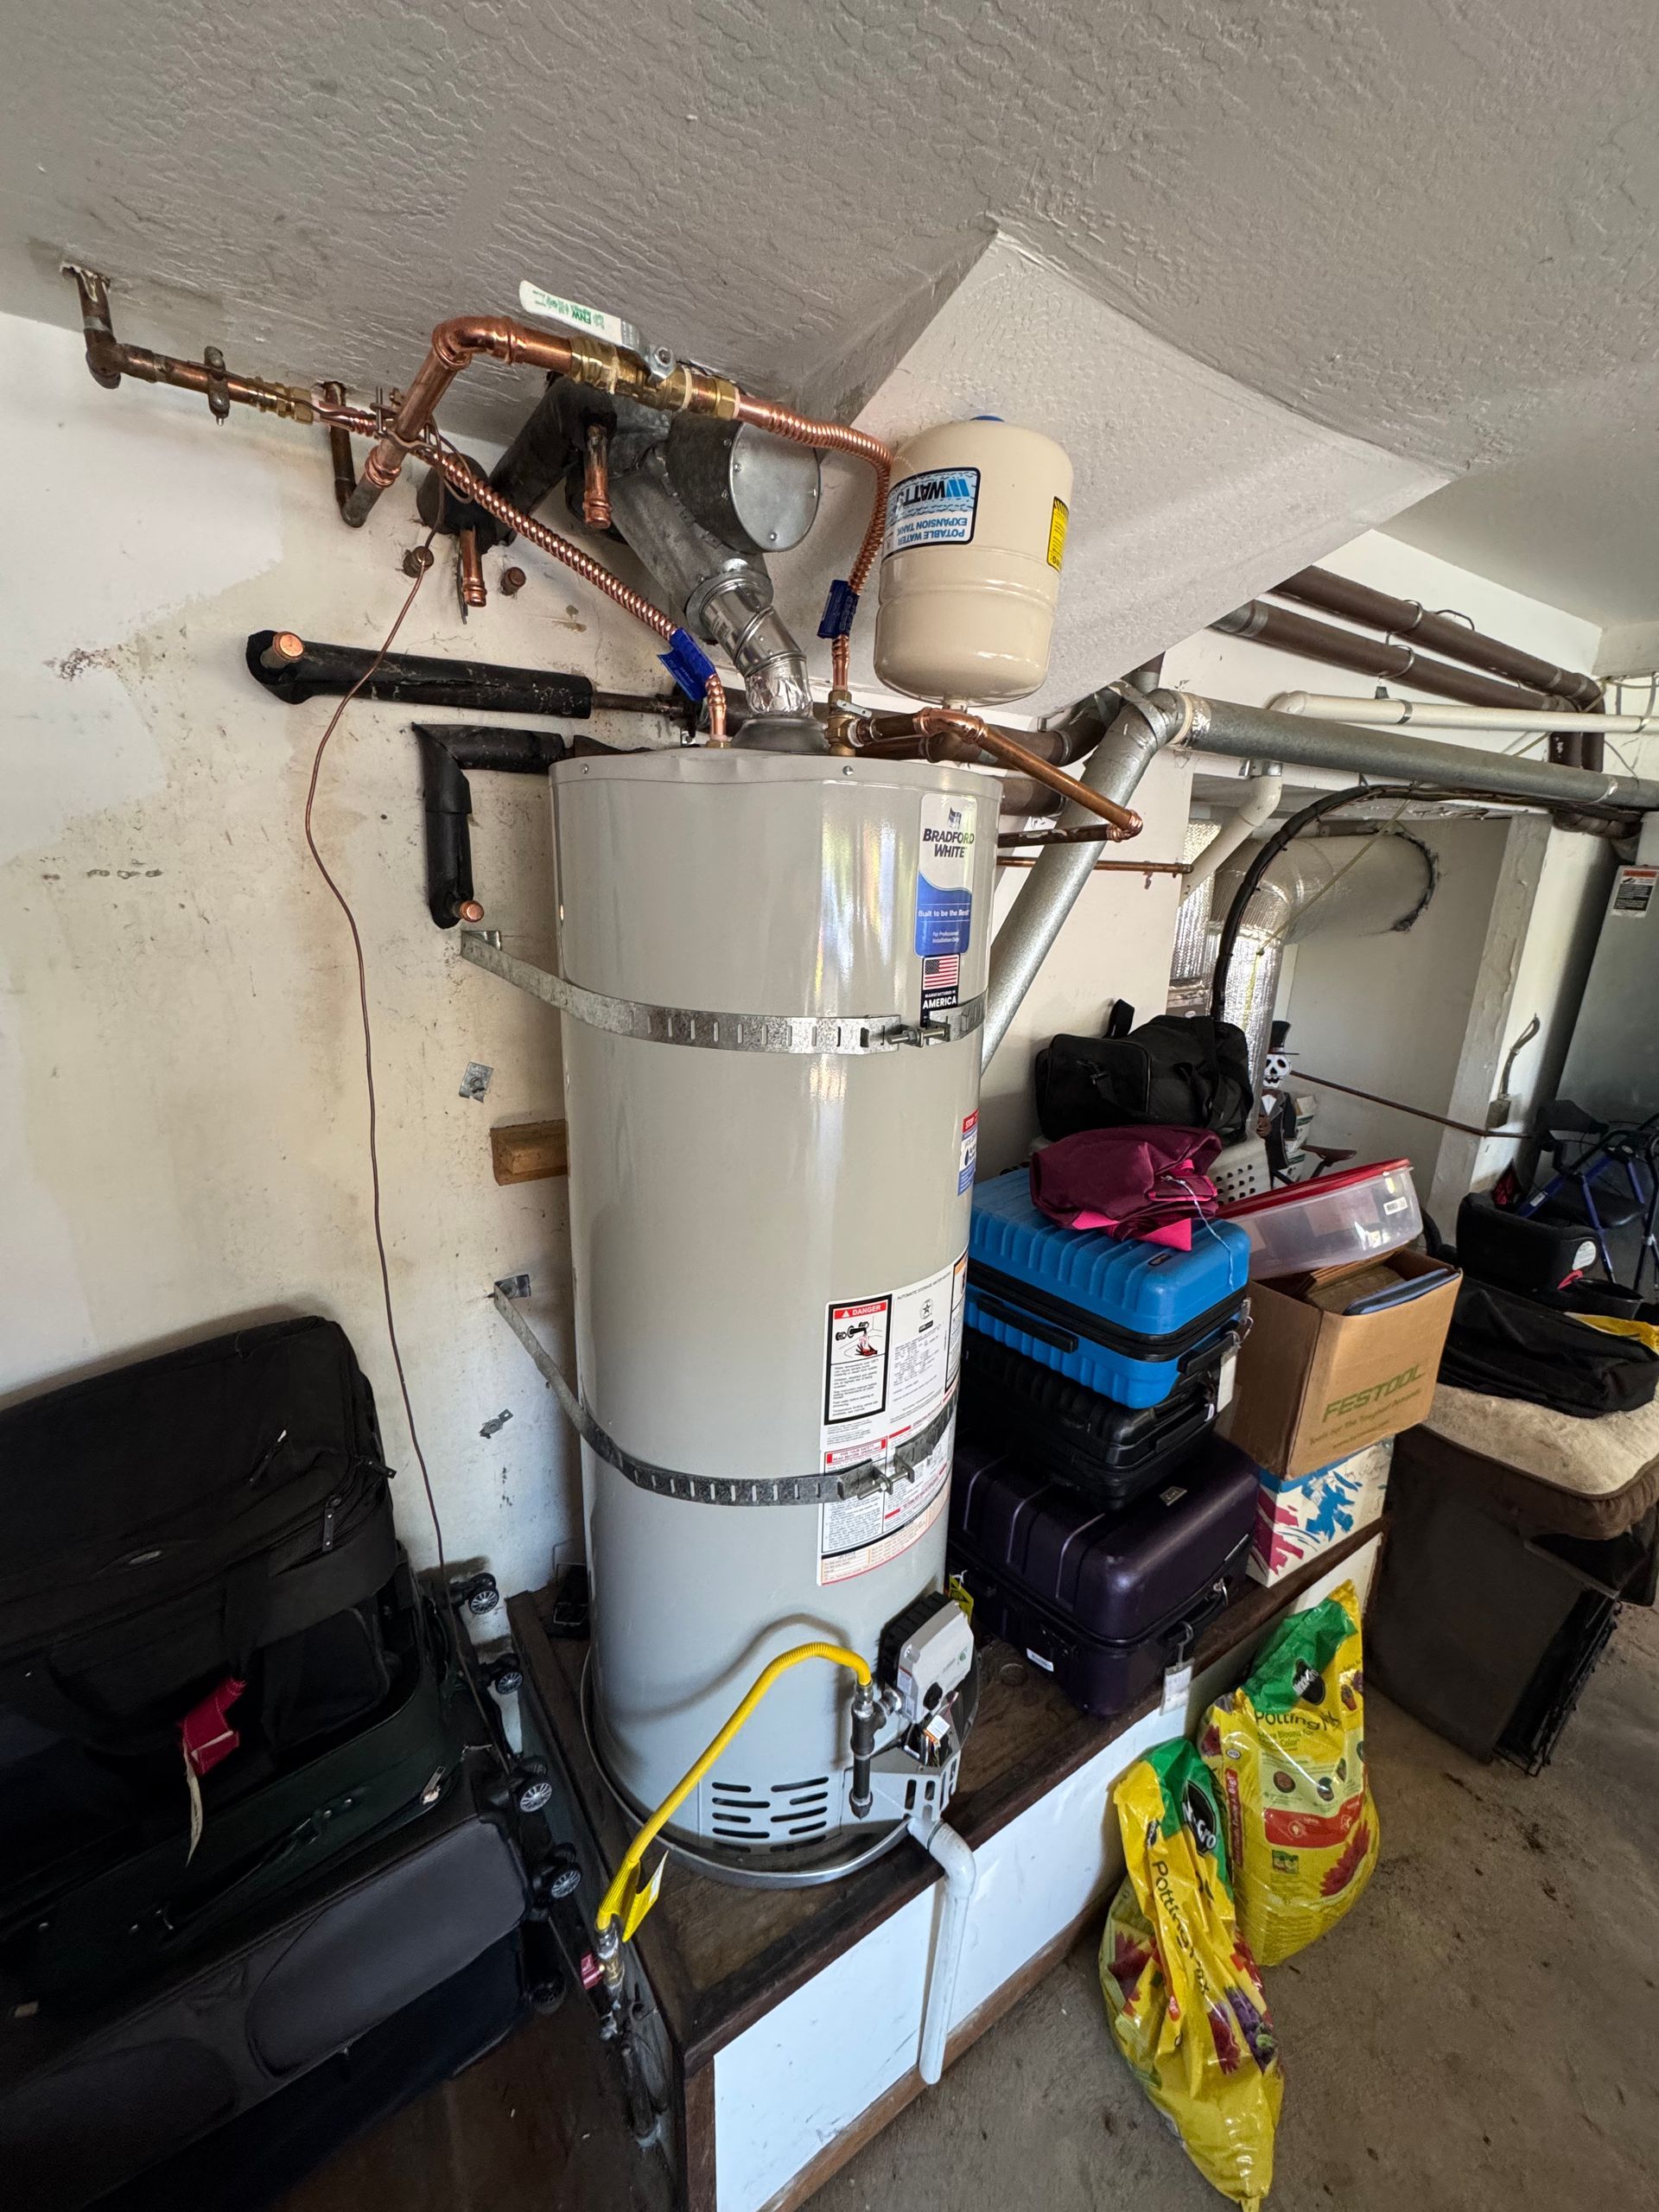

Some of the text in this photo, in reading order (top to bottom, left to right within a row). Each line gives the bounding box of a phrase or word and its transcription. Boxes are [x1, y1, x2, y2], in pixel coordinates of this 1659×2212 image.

[898, 518, 968, 535] EXPANSION TANK
[899, 529, 965, 545] POTABLE WATER
[923, 828, 975, 844] BRADFORD
[934, 843, 965, 858] WHITE
[923, 995, 957, 1009] AMERICA
[852, 1305, 881, 1315] DANGER
[1322, 1363, 1427, 1423] FESTOOL
[1255, 1711, 1320, 1731] Potting
